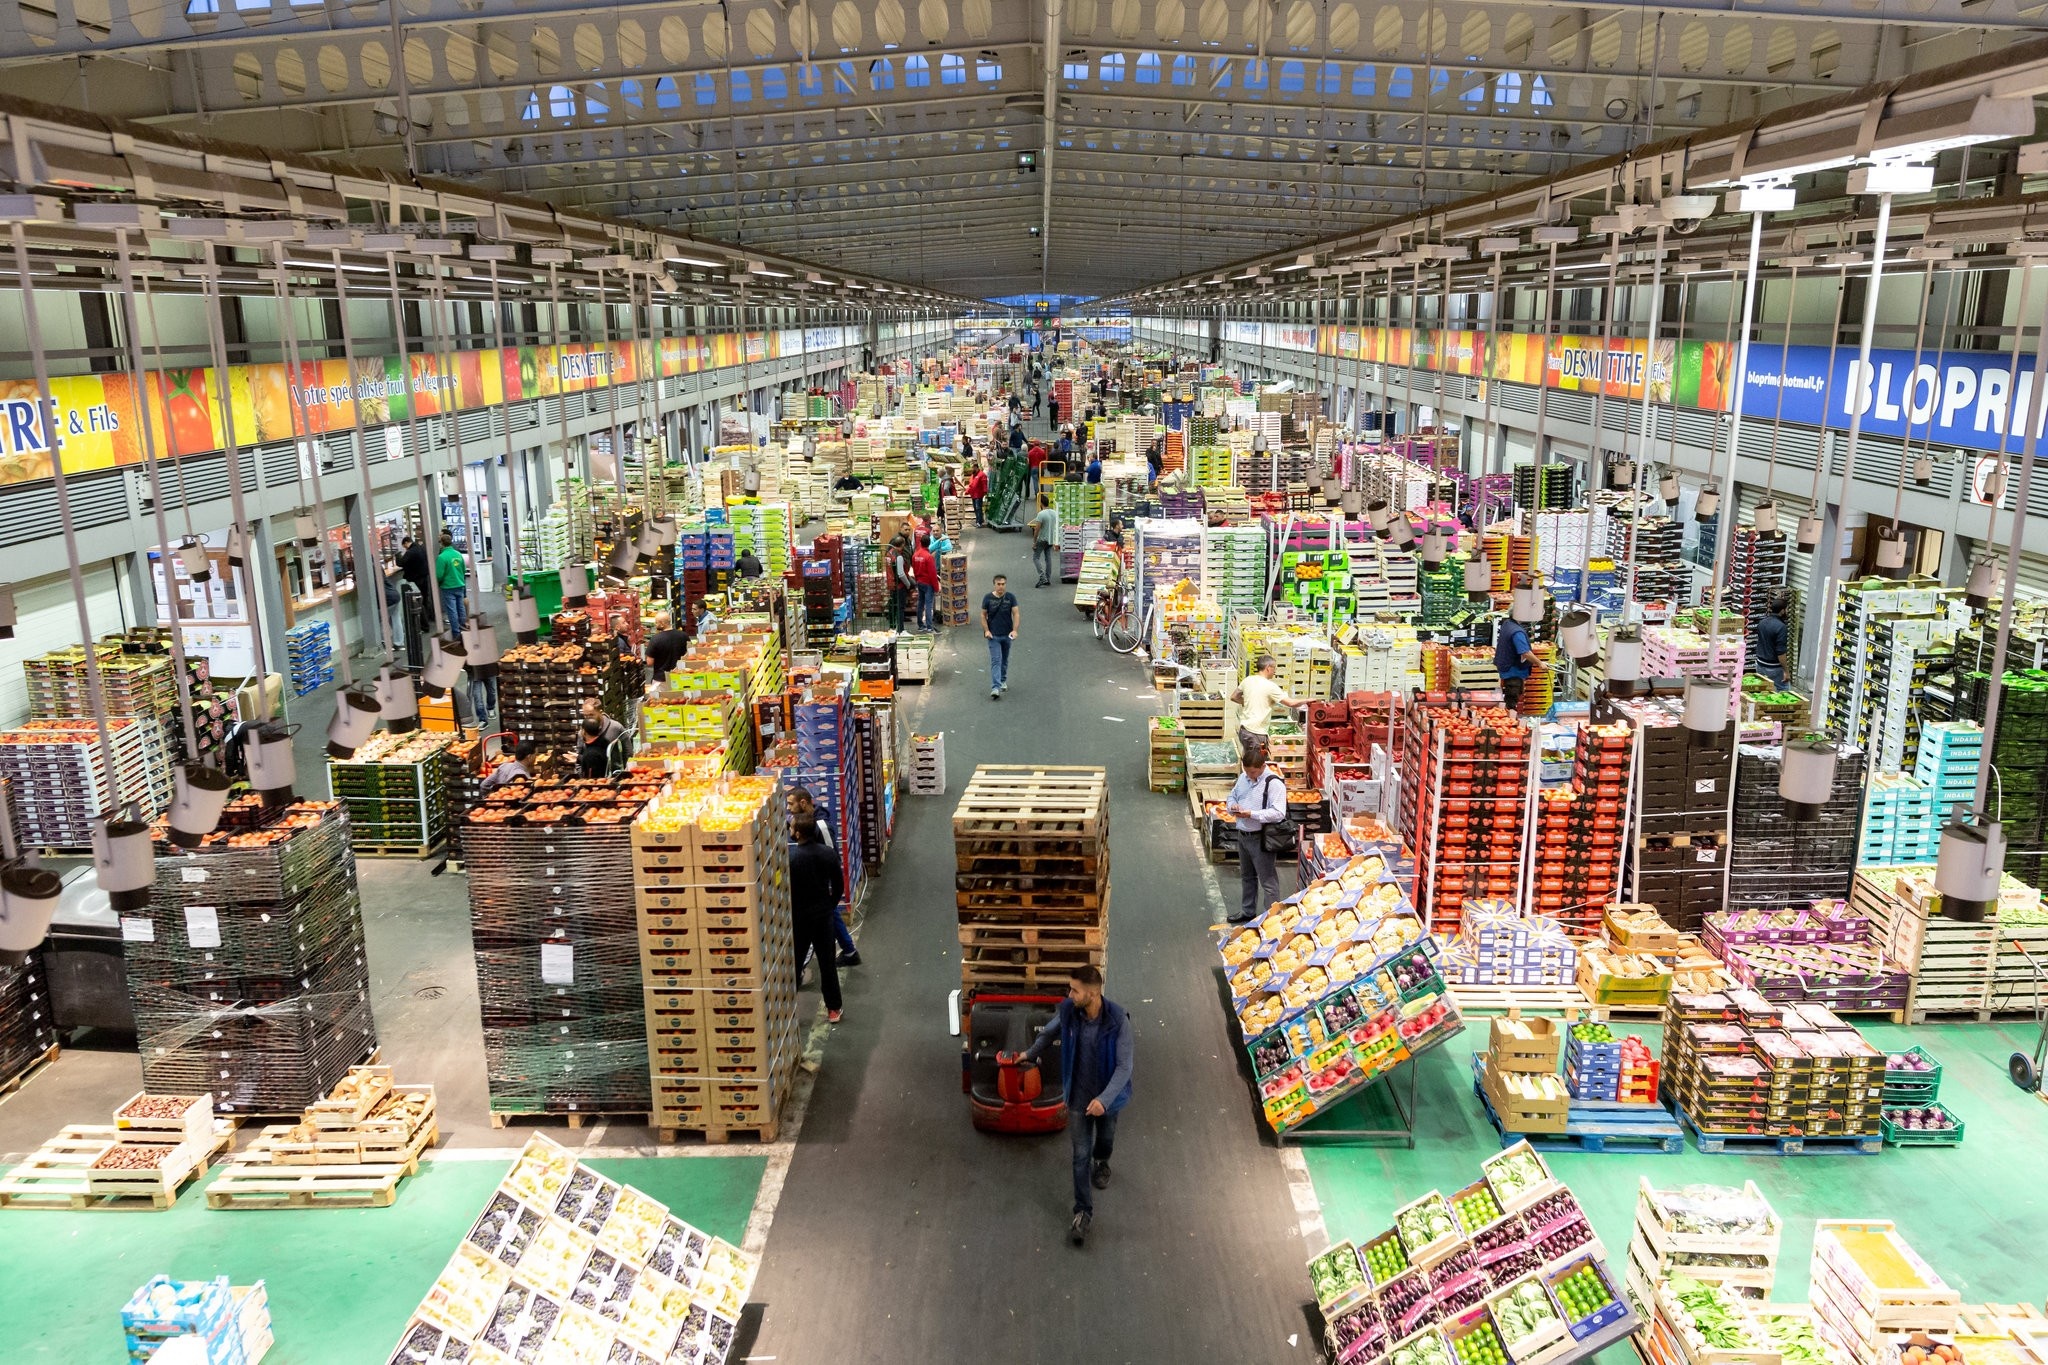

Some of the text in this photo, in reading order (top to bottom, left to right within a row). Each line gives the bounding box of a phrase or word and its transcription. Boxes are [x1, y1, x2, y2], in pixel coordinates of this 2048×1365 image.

[1009, 319, 1023, 328] A2
[331, 376, 385, 408] spécaliste
[422, 371, 458, 396] légms
[1843, 359, 2048, 440] BLOPRI
[0, 398, 119, 454] RE & Fils
[1945, 778, 1976, 786] INDASOL
